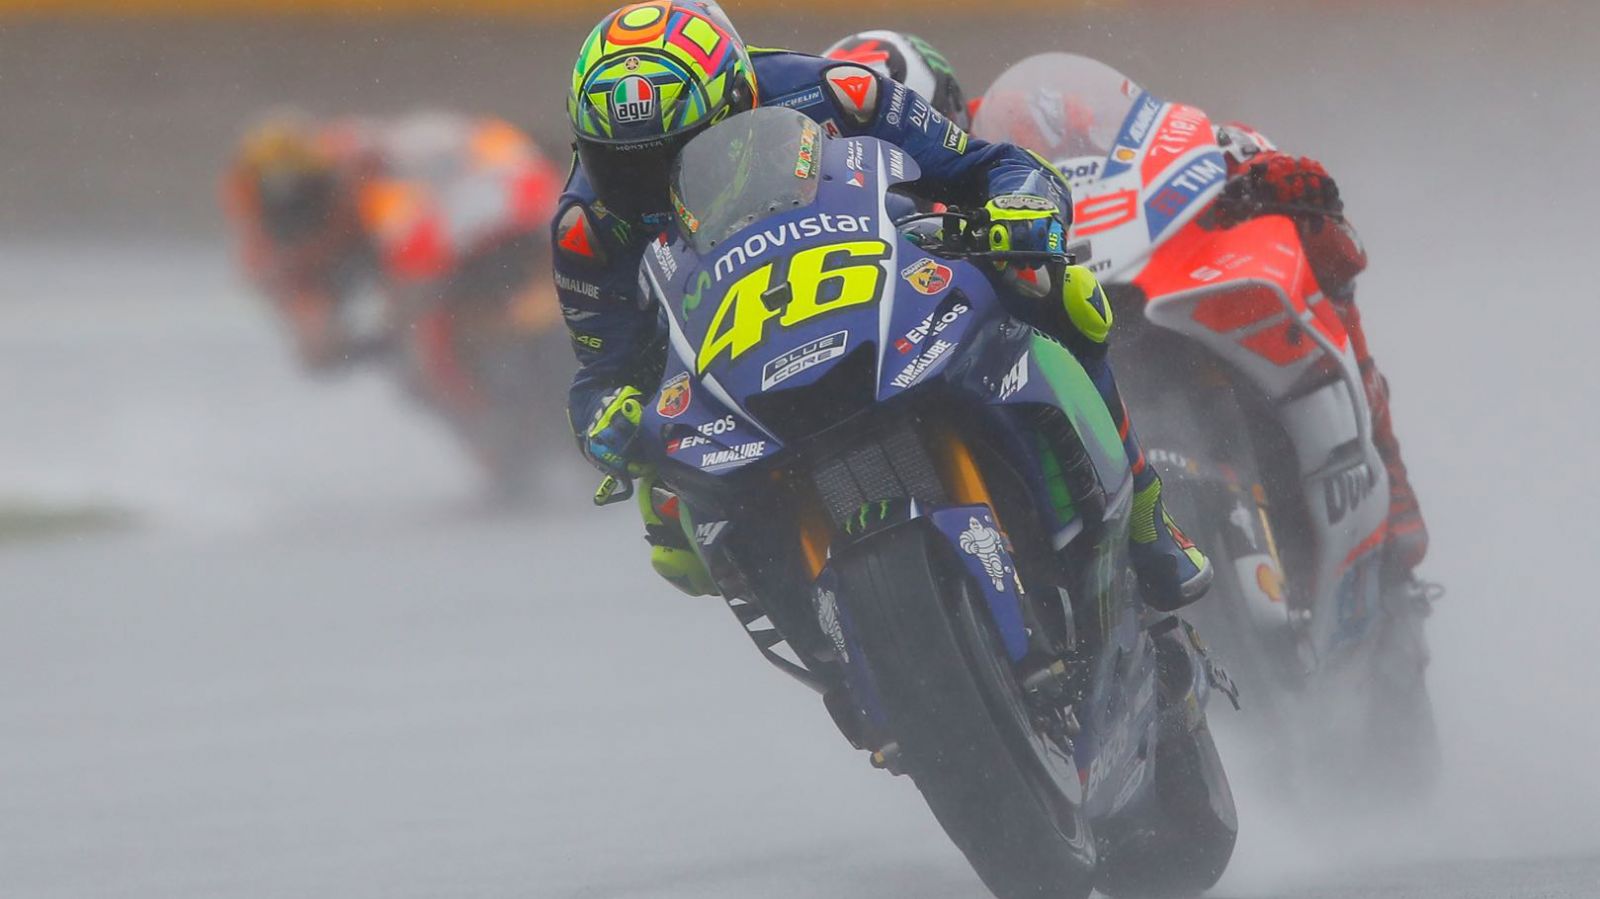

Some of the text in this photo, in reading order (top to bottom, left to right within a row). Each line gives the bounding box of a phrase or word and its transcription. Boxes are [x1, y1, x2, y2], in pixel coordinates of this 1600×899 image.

[1171, 159, 1224, 192] TIM
[714, 213, 871, 282] movistar
[697, 240, 887, 376] 46
[904, 303, 969, 345] ENEOS
[774, 337, 834, 369] BLUE
[774, 350, 832, 381] CORE
[890, 339, 952, 388] YAMALUBE
[680, 414, 736, 450] ENEOS
[701, 441, 766, 467] YAMALUBE
